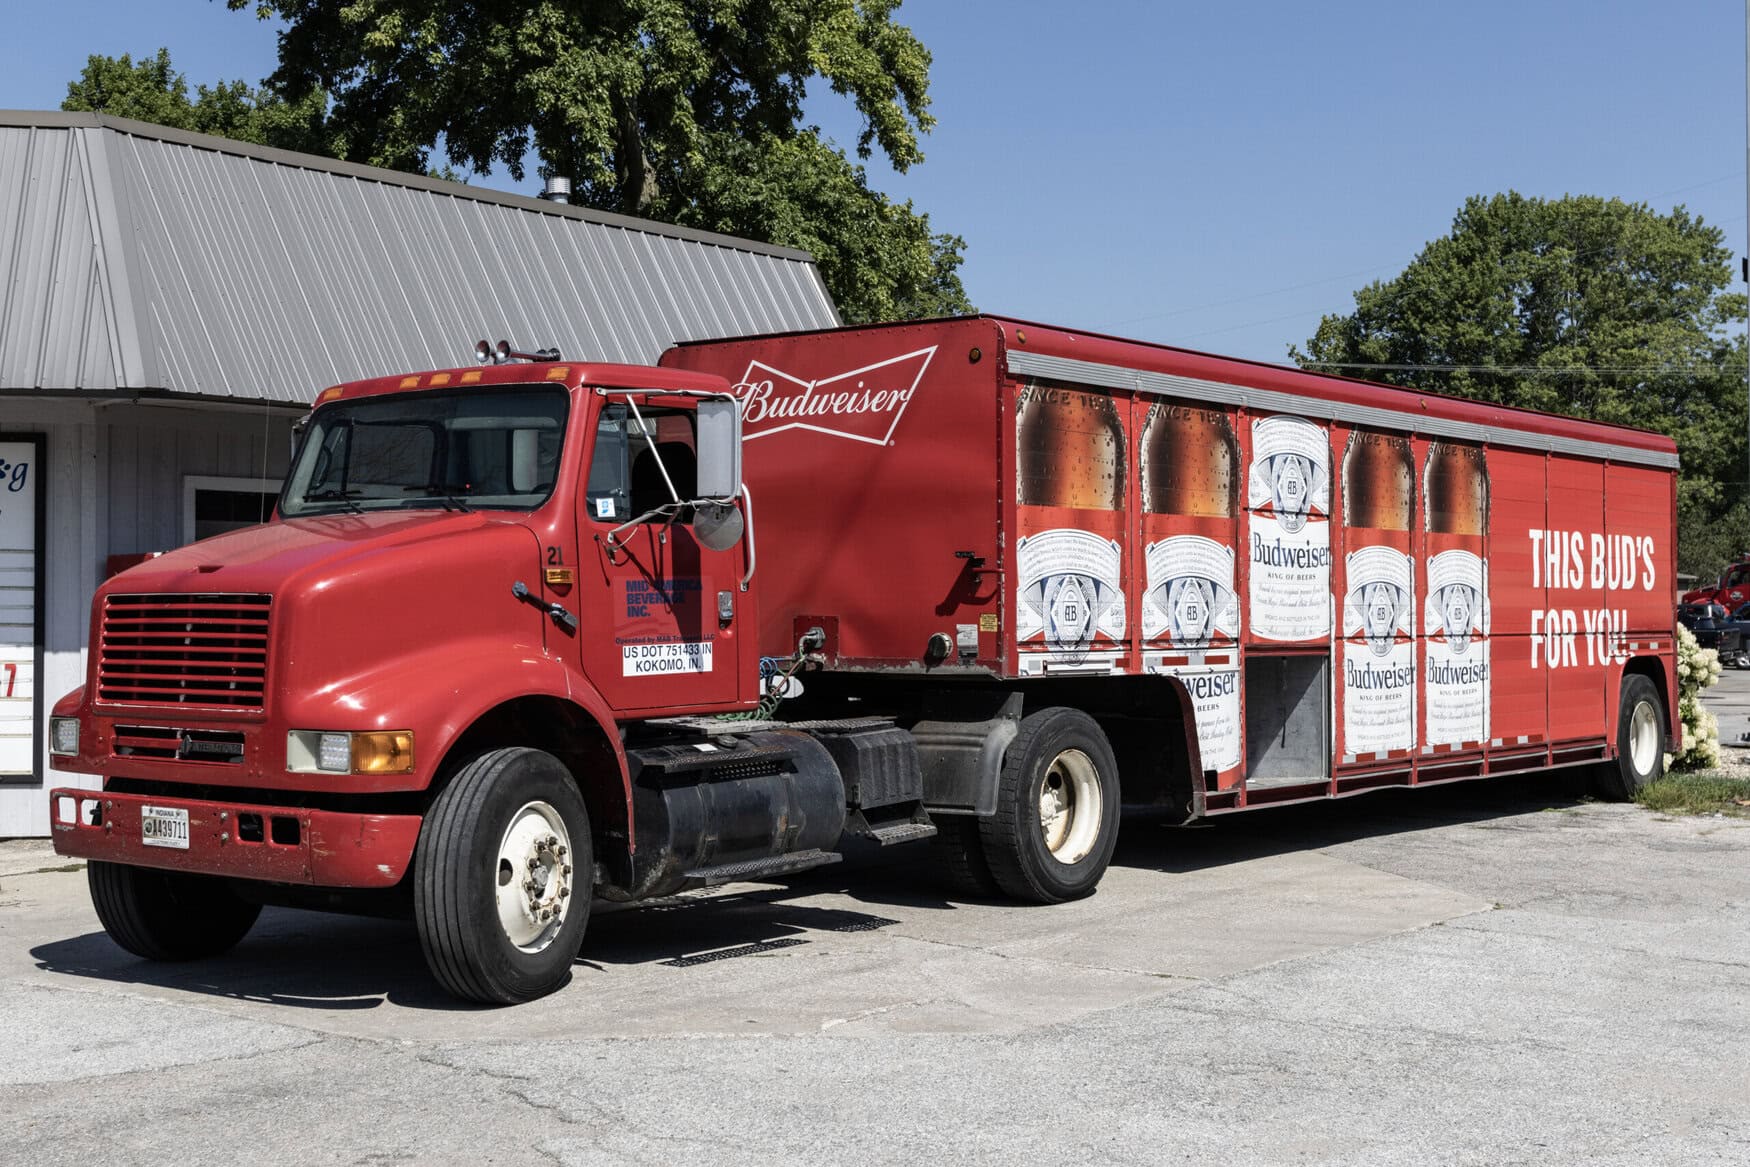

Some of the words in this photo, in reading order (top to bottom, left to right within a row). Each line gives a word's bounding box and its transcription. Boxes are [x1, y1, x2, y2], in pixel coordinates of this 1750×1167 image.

[731, 380, 909, 423] Budweiser
[1022, 386, 1071, 405] SINCE
[1151, 403, 1191, 421] SINCE
[1349, 432, 1380, 446] SINCE
[1429, 444, 1457, 456] SINCE
[547, 546, 563, 566] 21
[1252, 532, 1330, 568] Budweiser
[1529, 529, 1585, 590] THIS
[1591, 533, 1655, 591] BUD'S
[1267, 572, 1282, 580] KING
[626, 580, 649, 592] MID
[627, 605, 651, 618] INC.
[1530, 609, 1578, 669] FOR
[623, 646, 639, 659] US
[641, 646, 663, 657] DOT
[666, 644, 699, 657] 751433
[702, 643, 711, 655] IN
[636, 659, 686, 672] KOKOMO,
[688, 658, 702, 670] IN.
[1347, 658, 1415, 689] Budweiser
[1428, 656, 1488, 685] Budweiser
[1182, 672, 1235, 699] weiser
[1197, 703, 1220, 712] BEERS
[153, 819, 187, 839] A439711
